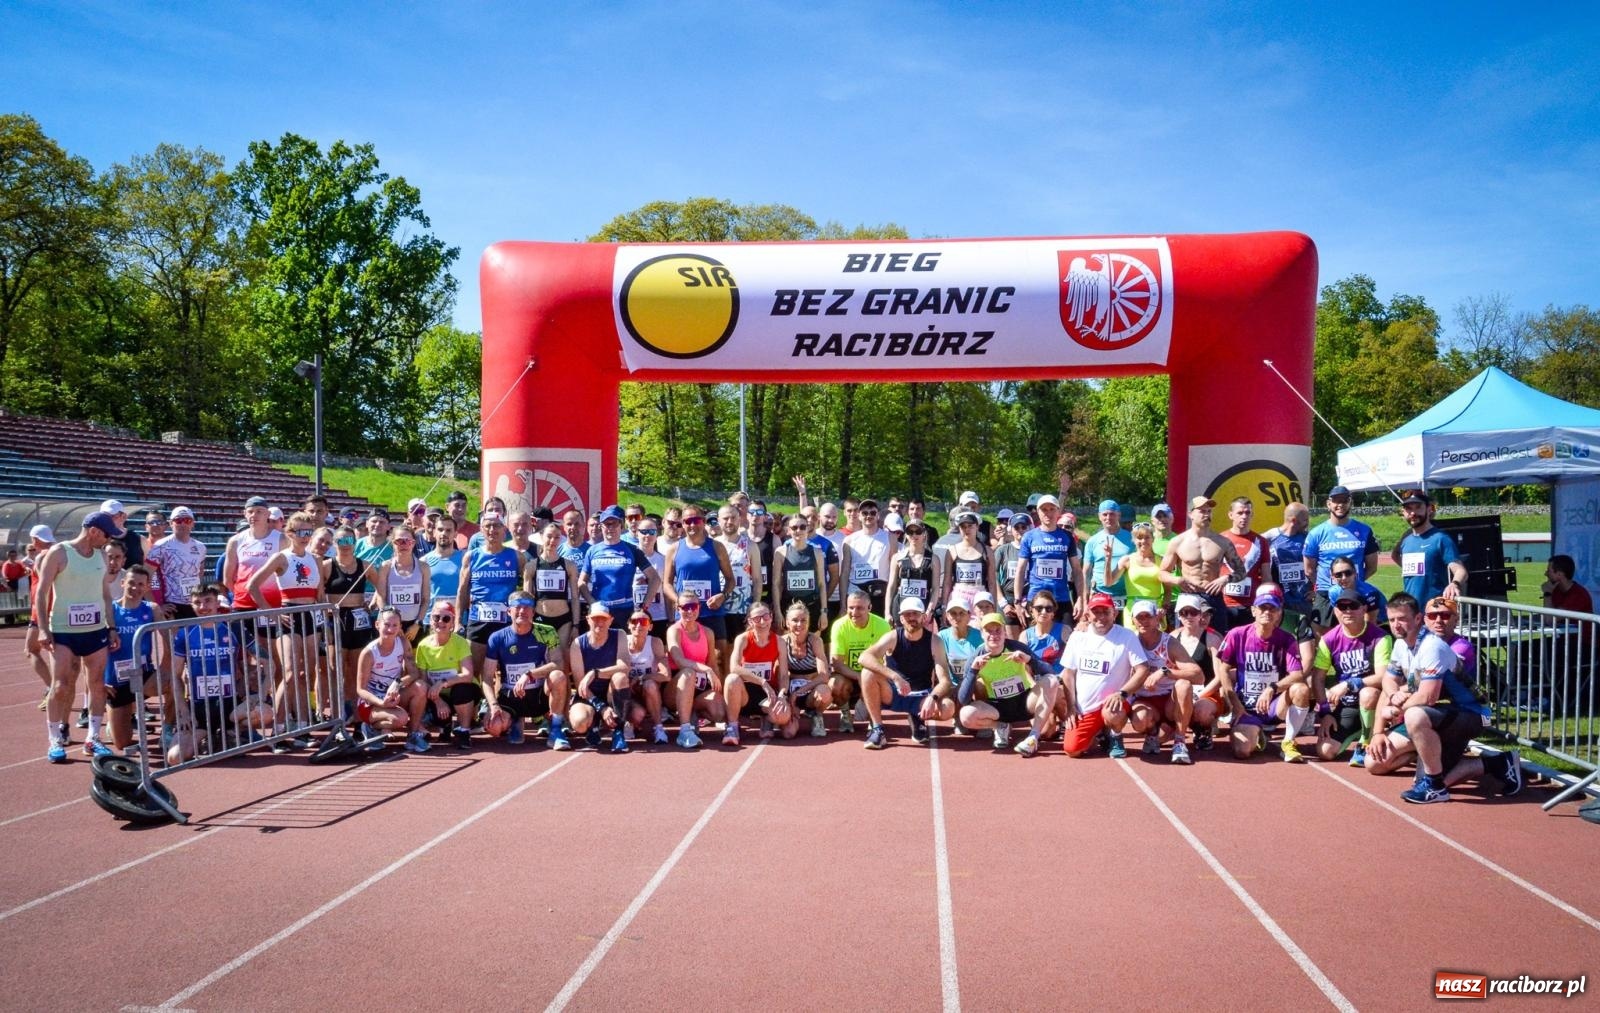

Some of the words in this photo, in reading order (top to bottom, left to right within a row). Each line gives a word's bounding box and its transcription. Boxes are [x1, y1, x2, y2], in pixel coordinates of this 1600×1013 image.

[842, 252, 942, 272] BIEG
[677, 266, 737, 287] SIR
[770, 289, 854, 316] BEZ
[860, 286, 1016, 315] GRANIC
[791, 325, 995, 356] RACIBÓRZ
[1257, 481, 1304, 507] SIR
[1031, 544, 1068, 553] RUNNERS
[1318, 540, 1366, 550] RUNNERS
[590, 557, 632, 565] RUNNERS
[472, 570, 517, 578] RUNNERS
[858, 569, 871, 578] 227
[960, 571, 974, 579] 233
[1042, 567, 1054, 576] 115
[1283, 570, 1299, 579] 239
[543, 579, 554, 588] 111
[792, 579, 806, 587] 210
[904, 586, 919, 595] 228
[1228, 584, 1242, 593] 173
[395, 593, 411, 603] 182
[74, 613, 93, 623] 102
[483, 610, 498, 619] 129
[1084, 658, 1100, 669] 132
[998, 685, 1014, 695] 197
